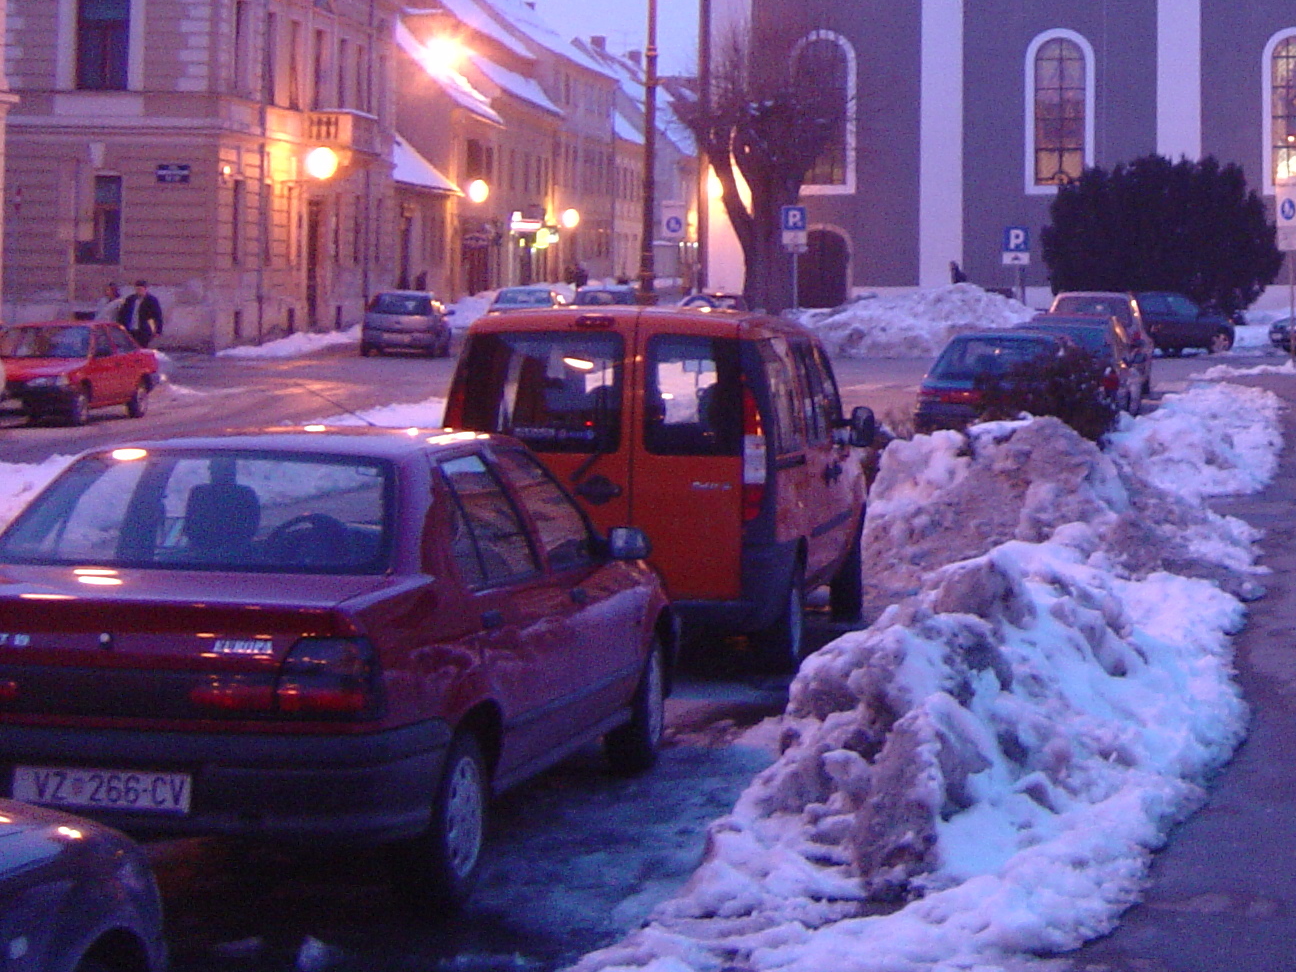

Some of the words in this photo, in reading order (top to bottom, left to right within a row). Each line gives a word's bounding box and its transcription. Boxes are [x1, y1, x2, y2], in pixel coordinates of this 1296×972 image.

[788, 210, 801, 227] P
[1010, 229, 1025, 249] P
[35, 771, 68, 800] VZ
[89, 773, 184, 806] 266-CV
